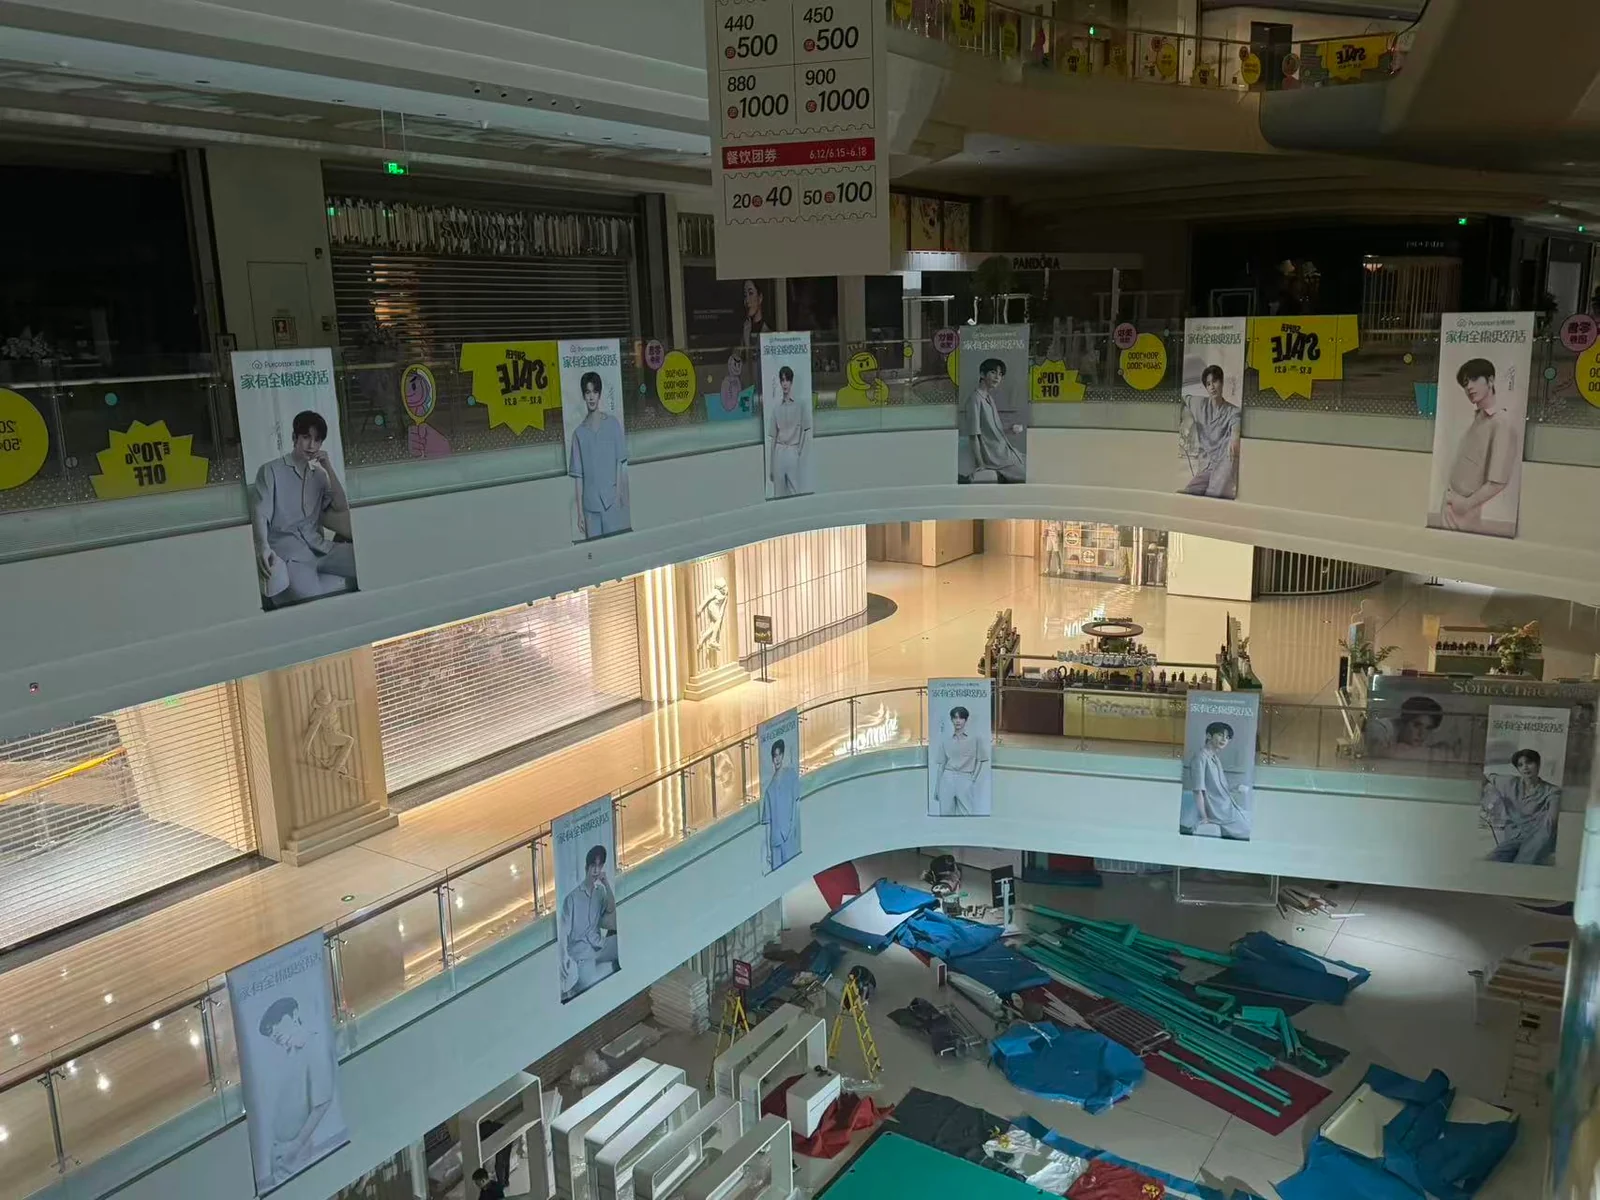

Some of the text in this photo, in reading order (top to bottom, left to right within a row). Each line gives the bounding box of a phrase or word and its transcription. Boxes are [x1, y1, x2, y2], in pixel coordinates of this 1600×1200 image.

[724, 14, 754, 32] 440
[803, 6, 834, 23] 450
[737, 33, 778, 58] 500
[816, 26, 859, 51] 500
[727, 74, 756, 92] 880
[805, 68, 836, 86] 900
[739, 93, 789, 118] 1000
[818, 87, 870, 112] 1000
[726, 148, 777, 165] 餐饮团券
[809, 146, 868, 160] 6.12/6.15-6.18
[732, 193, 751, 209] 20
[766, 185, 793, 207] 40
[802, 189, 822, 205] 50
[836, 181, 873, 203] 100
[1012, 256, 1061, 269] PANDORA
